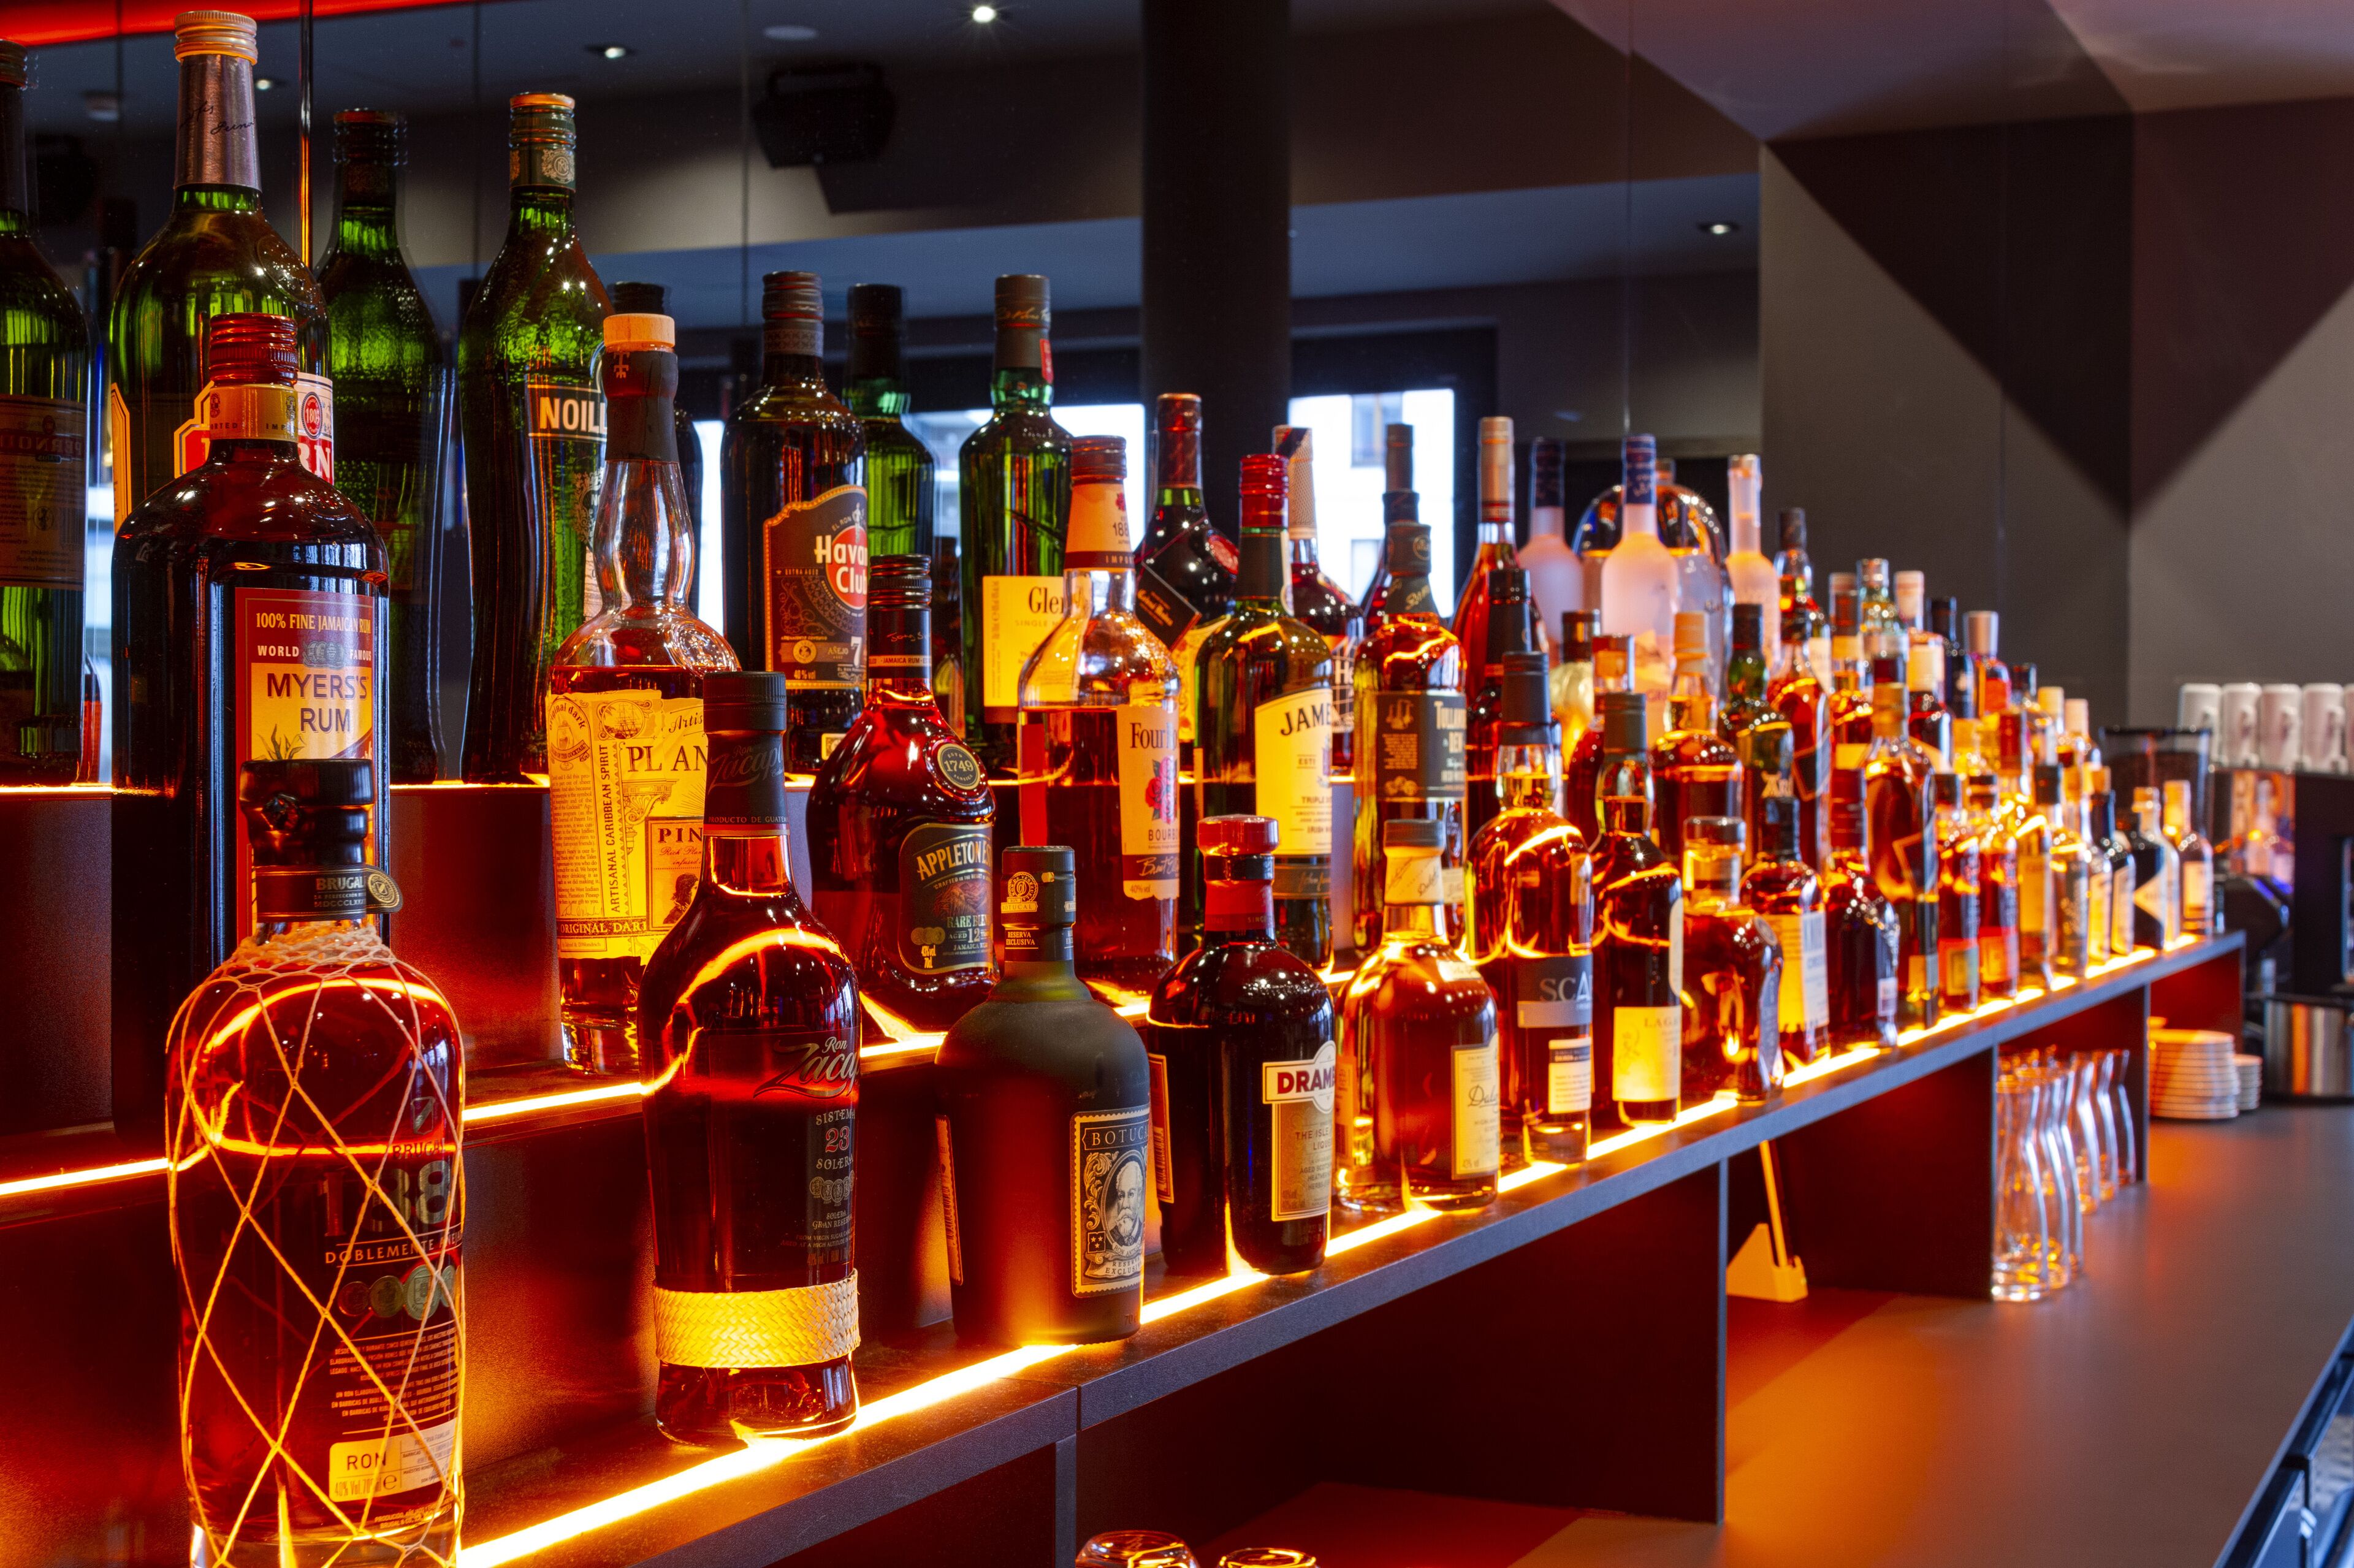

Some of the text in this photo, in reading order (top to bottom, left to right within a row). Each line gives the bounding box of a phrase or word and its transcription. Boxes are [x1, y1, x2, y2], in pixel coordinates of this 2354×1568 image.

[256, 613, 371, 634] 100% FINE JAMAICAN RUM
[258, 645, 371, 661] WORLD FAMOUS
[828, 645, 848, 655] AÑEJO
[851, 636, 863, 668] 7
[267, 673, 368, 699] MYERS'S
[300, 708, 351, 733] RUM
[568, 702, 587, 730] dark
[1130, 722, 1165, 748] Four
[734, 745, 752, 755] Ron
[944, 759, 974, 772] 1749
[599, 745, 620, 913] ARTISANAL CARIBBEAN SPIRIT
[658, 828, 703, 843] PIN
[916, 840, 981, 881] APPLETON
[316, 876, 364, 891] BRUGAL
[1130, 884, 1143, 894] 40%
[560, 923, 608, 934] ORIGINAL
[947, 914, 972, 928] RARE
[967, 927, 980, 943] 12
[953, 943, 979, 951] JAMAICA
[1539, 970, 1592, 1002] SCA
[821, 1036, 848, 1054] Ron
[825, 1125, 850, 1152] 23
[1295, 1127, 1329, 1141] THE ISLE
[392, 1138, 445, 1159] BRUGAL
[816, 1153, 854, 1170] SOLERA
[326, 1238, 434, 1264] DOBLEMENTE
[347, 1451, 386, 1471] RON
